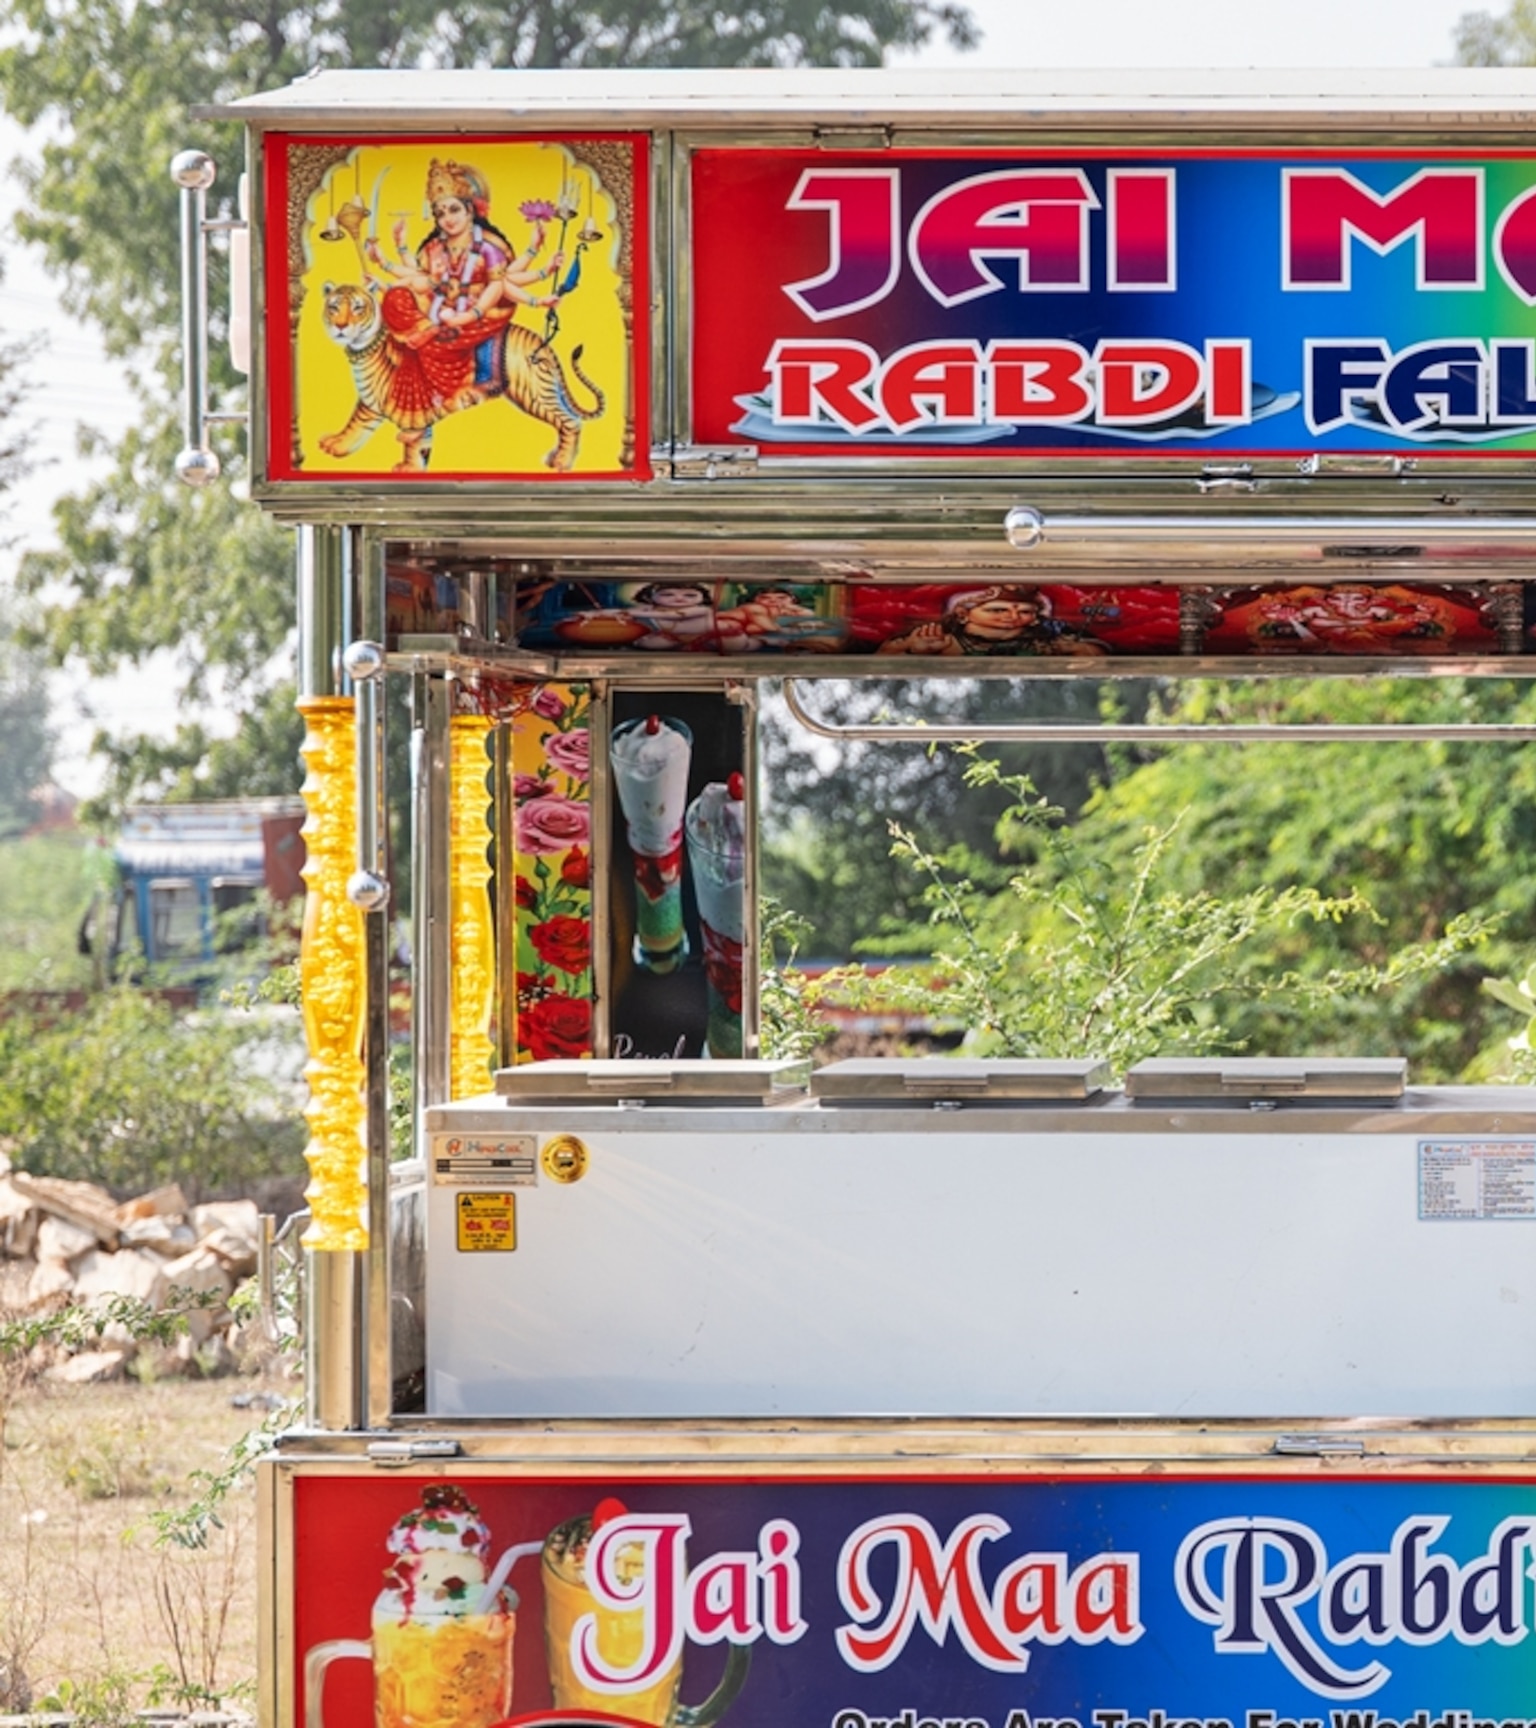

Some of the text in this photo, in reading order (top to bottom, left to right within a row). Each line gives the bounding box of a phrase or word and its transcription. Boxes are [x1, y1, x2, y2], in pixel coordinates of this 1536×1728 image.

[783, 167, 1177, 322] JAI
[764, 338, 1252, 436] RABDI
[569, 1512, 807, 1695] Jai
[834, 1512, 1145, 1673] Maa
